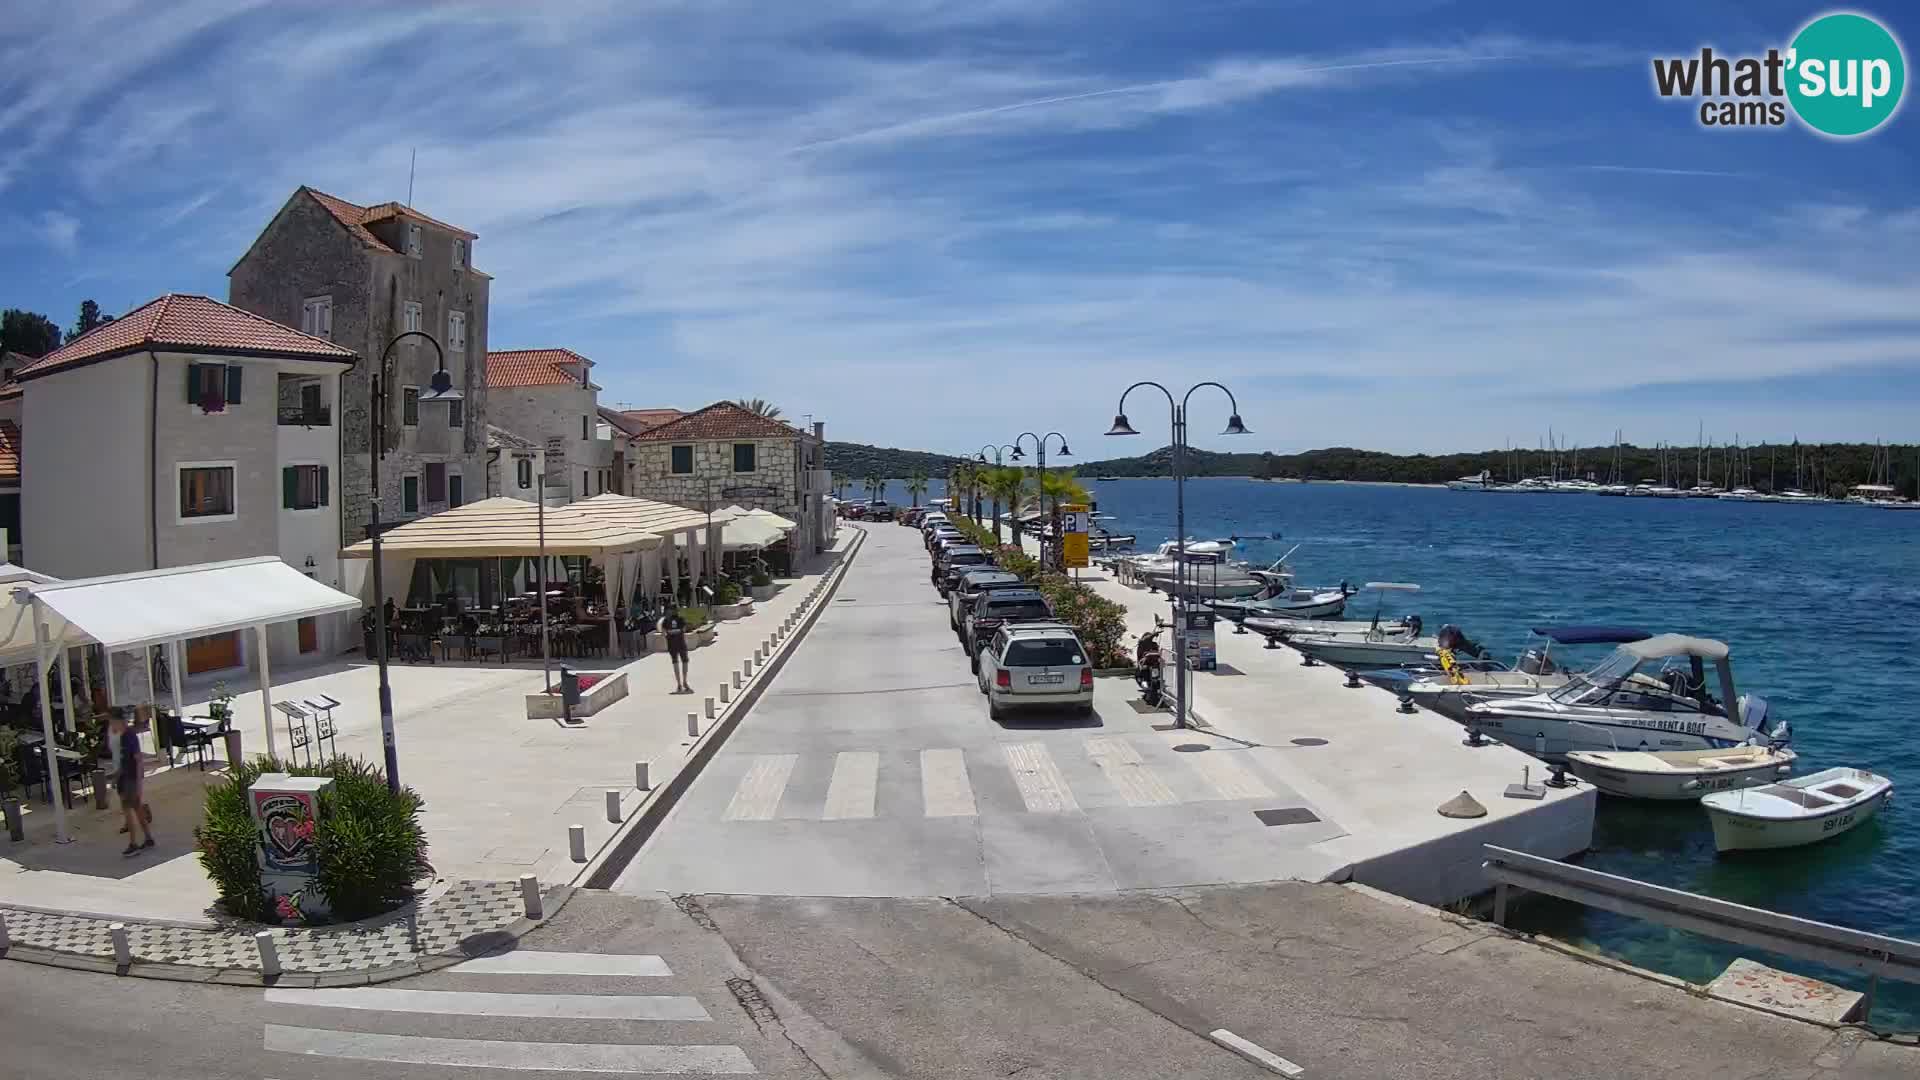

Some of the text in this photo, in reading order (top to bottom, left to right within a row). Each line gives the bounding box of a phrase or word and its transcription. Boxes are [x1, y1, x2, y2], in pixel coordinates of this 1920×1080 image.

[1065, 514, 1076, 531] P
[1657, 719, 1678, 732] RENT
[1686, 721, 1706, 735] BOAT
